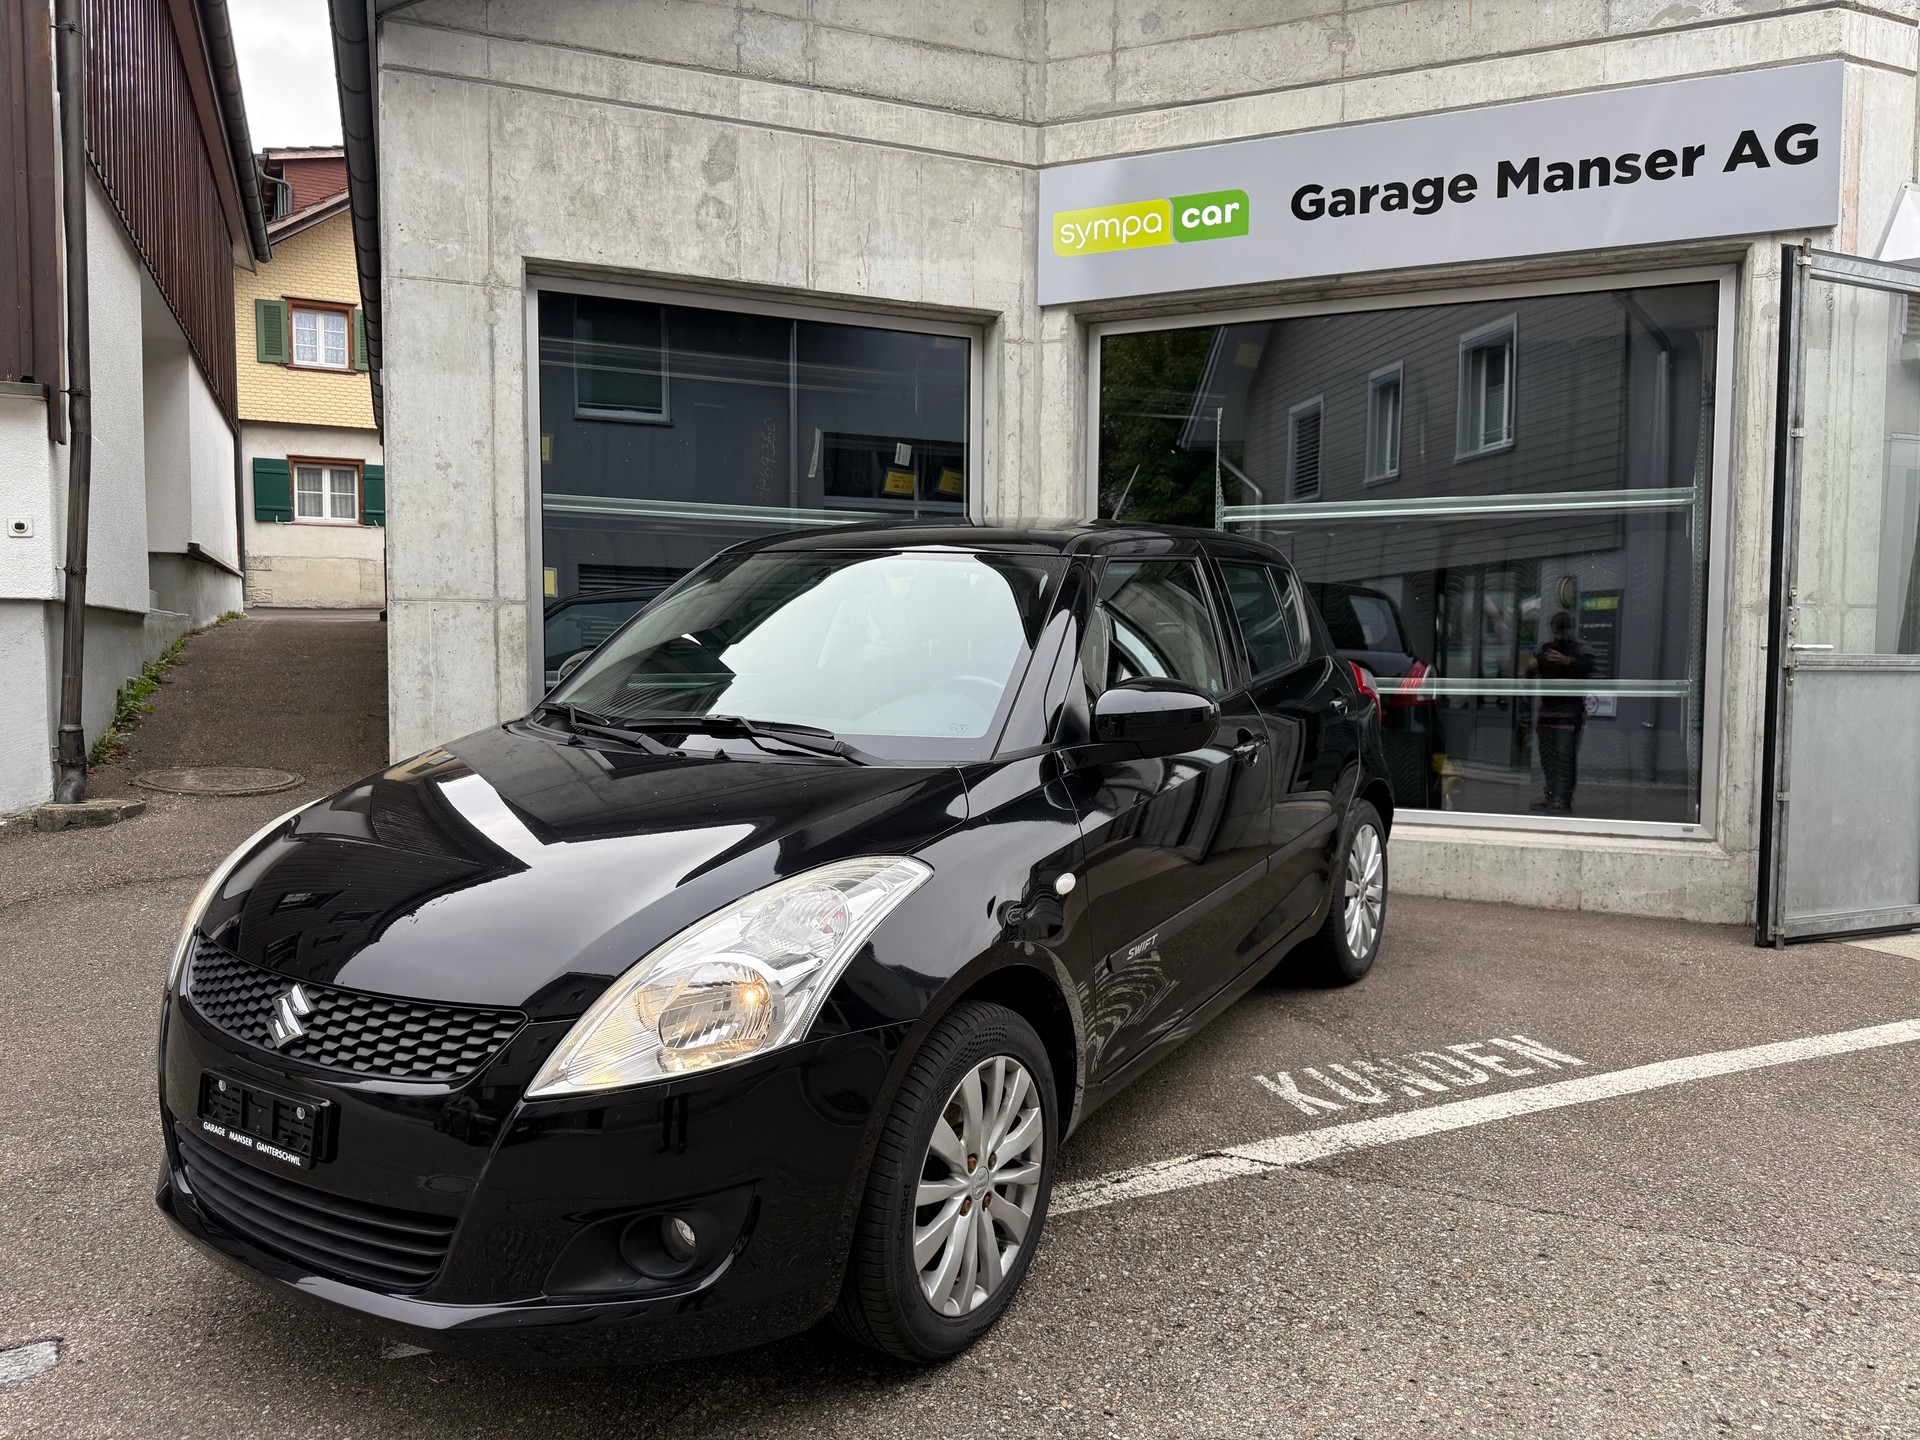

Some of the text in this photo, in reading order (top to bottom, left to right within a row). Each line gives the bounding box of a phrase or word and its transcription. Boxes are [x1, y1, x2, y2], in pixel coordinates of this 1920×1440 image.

[1290, 122, 1819, 222] Garage Manser AG
[1060, 202, 1240, 249] sympa car
[1126, 932, 1159, 961] SWIFT
[1253, 1034, 1588, 1115] KUNDEN
[203, 1121, 301, 1166] GARAGE MANSER GANTERSCHWIL
